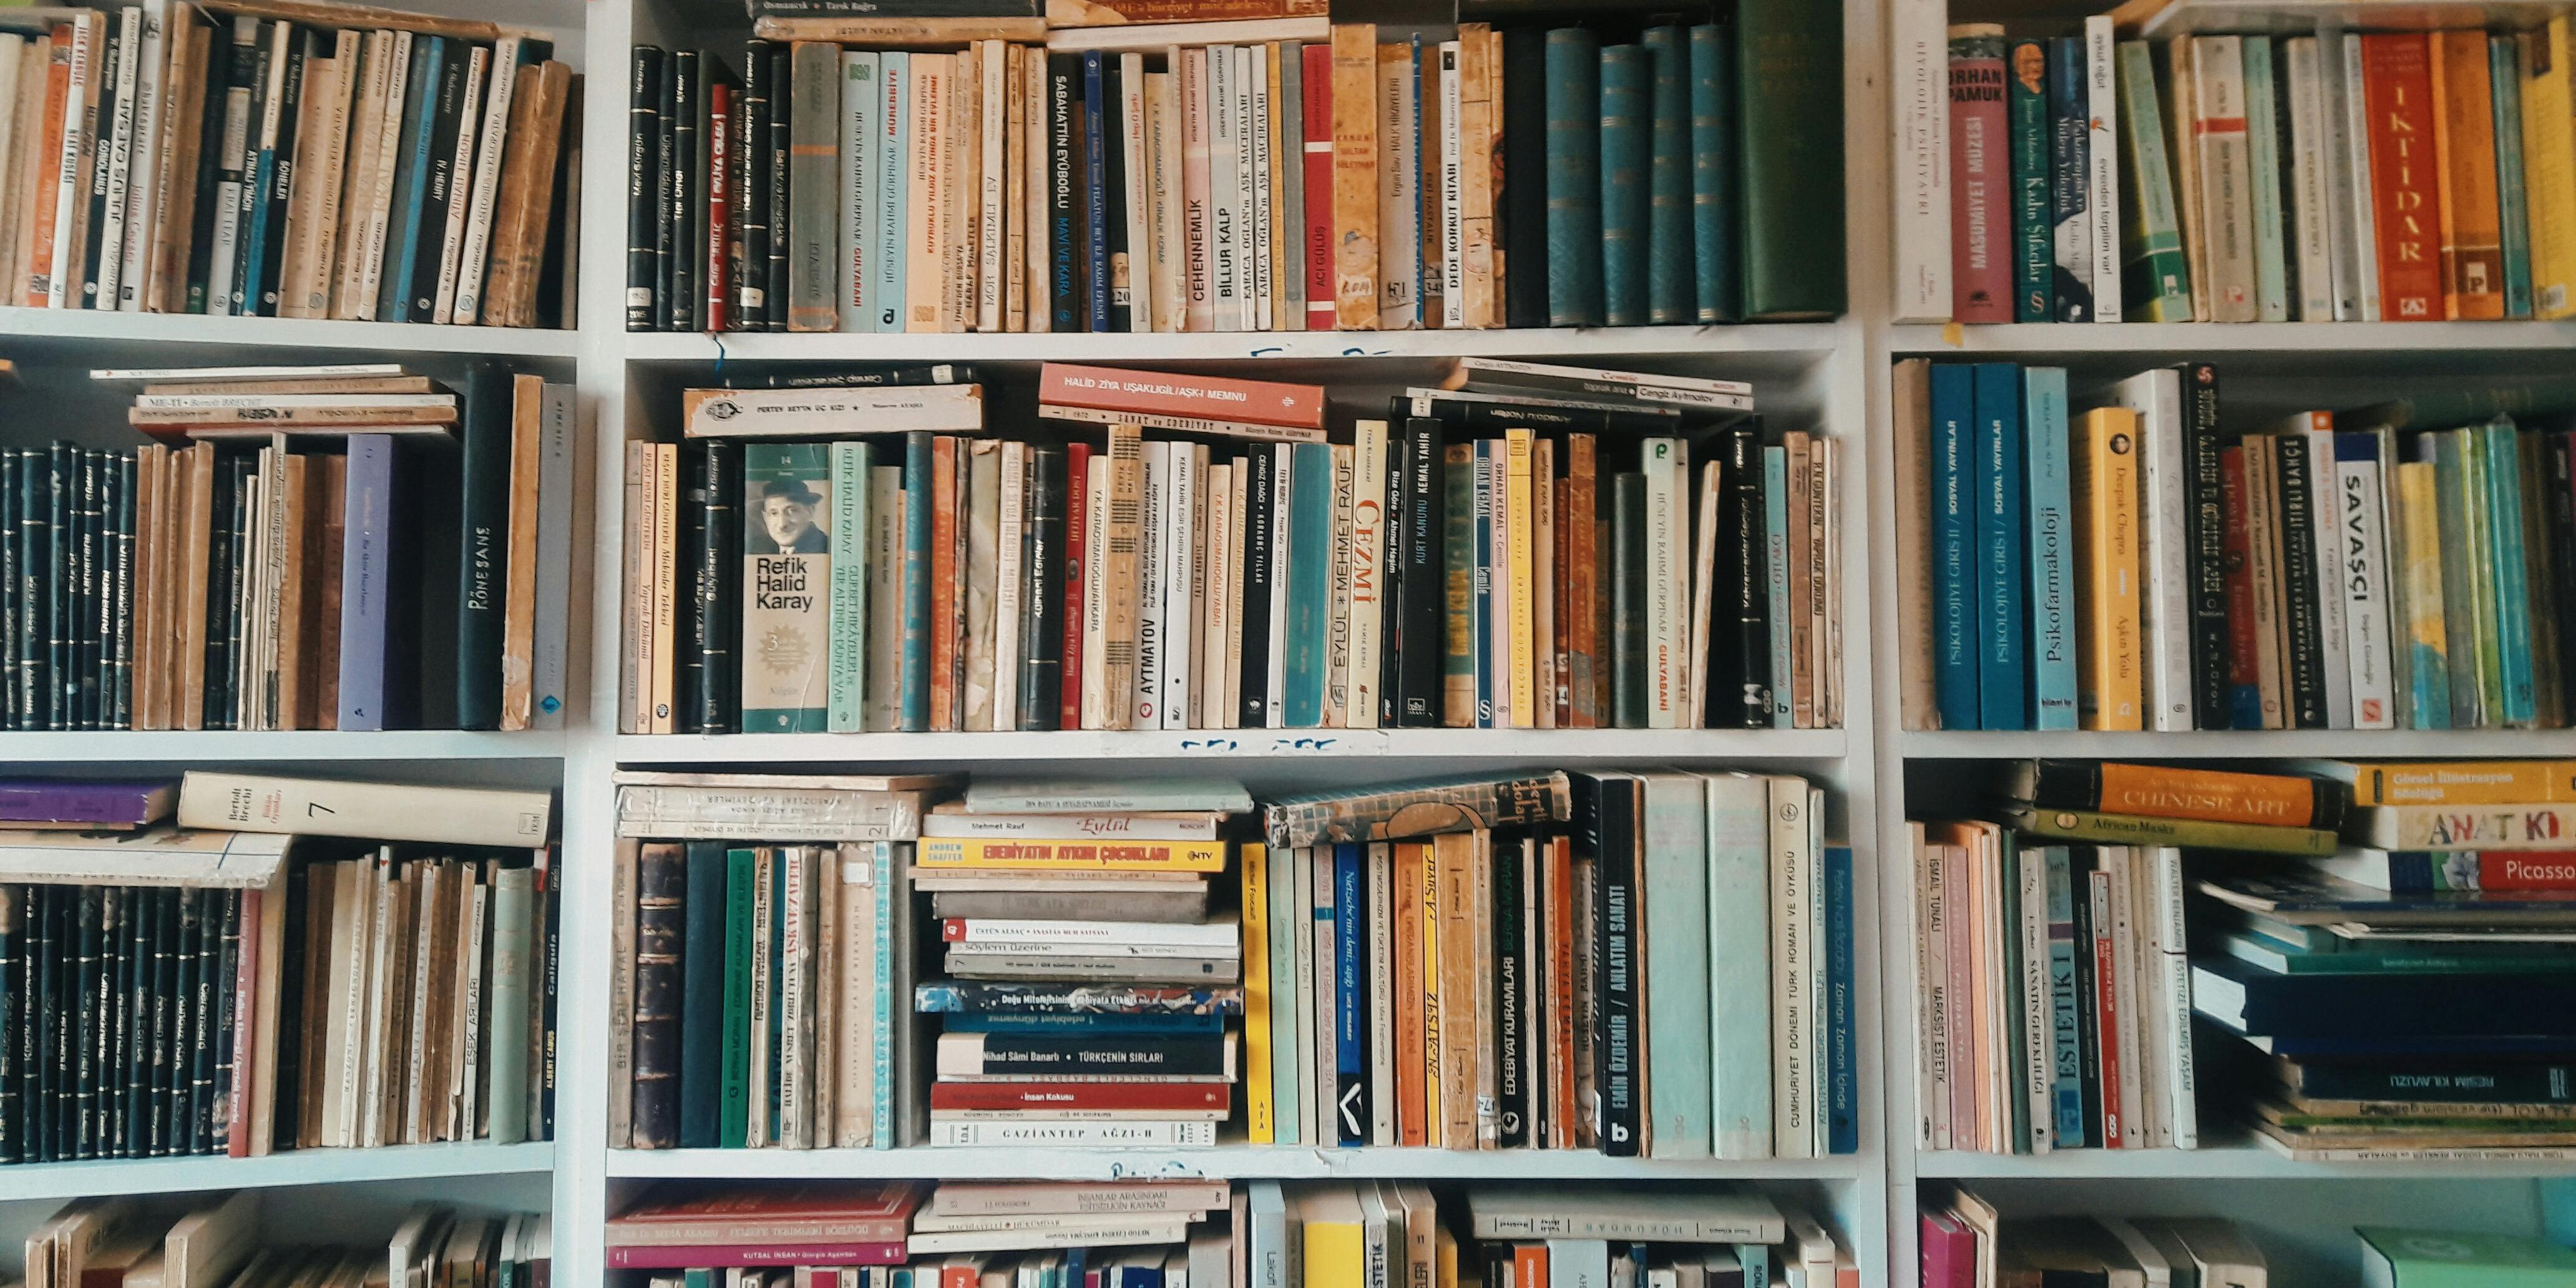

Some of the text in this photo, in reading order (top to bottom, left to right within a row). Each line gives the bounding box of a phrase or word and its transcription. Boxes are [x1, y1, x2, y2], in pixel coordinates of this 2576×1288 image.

[112, 97, 131, 224] JULIUS CAESAR
[927, 74, 938, 253] KUYRUKLU YILDIZ ALTINDA BİR EVLENME
[1256, 93, 1267, 163] MACERALARI
[1053, 76, 1071, 296] SABAHATTİN EYÜBOĞLU MAVİ VE KARA
[1257, 170, 1267, 190] AŞK
[1968, 117, 1986, 268] MASUMİYET MÜZESİ
[1189, 199, 1205, 301] CEHENNEMLİK
[1217, 208, 1232, 298] BİLLUR KALP
[1445, 163, 1459, 288] DEDE KORKUT KİTABI
[1258, 255, 1268, 298] KARACA
[1064, 377, 1096, 388] HALİD
[1098, 379, 1120, 390] ZİYA
[1207, 391, 1247, 402] MEMNU
[1948, 421, 1958, 471] YAYINLAR
[1388, 471, 1400, 573] Bize Göre Ahmet Haşim
[1415, 432, 1430, 564] KURT KANUNU KEMAL TAHİR
[1496, 463, 1505, 568] ORHAN KEMAL Cemile
[1948, 474, 1958, 514] SOSYAL
[2346, 476, 2369, 602] SAVAŞÇI
[756, 594, 813, 612] Karay
[758, 558, 809, 574] Refik
[758, 576, 807, 592] Halid
[1334, 460, 1350, 667] EYLÜL MEHMET RAUF
[2042, 507, 2062, 662] Psikofarmakoloji
[1141, 619, 1155, 695] AYTMATOV
[229, 788, 242, 821] Bertolt
[241, 789, 251, 822] Brecht
[308, 803, 335, 819] 7
[1083, 818, 1129, 834] Eylül
[1609, 885, 1628, 1109] EMİN ÖZDEMİR ANLATIM SANATI
[1785, 851, 1800, 1128] CUMHURİYET DÖNEMİ TÜRK ROMAN VE ÖYKÜSÜ
[1930, 859, 1946, 1083] İSMAİL TUNALI MARKSİST ESTETİK
[983, 1051, 1005, 1062] Nihad
[1008, 1050, 1029, 1062] Sâmi
[1078, 1051, 1126, 1064] TÜRKÇENİN
[1129, 1053, 1163, 1063] SIRLARI
[1503, 957, 1515, 1095] EDEBİYAT KURAMLARI
[2051, 970, 2077, 1080] ESTETİK
[1003, 1127, 1086, 1138] GAZİANTEP
[1024, 1091, 1074, 1101] İnsan Kokusu
